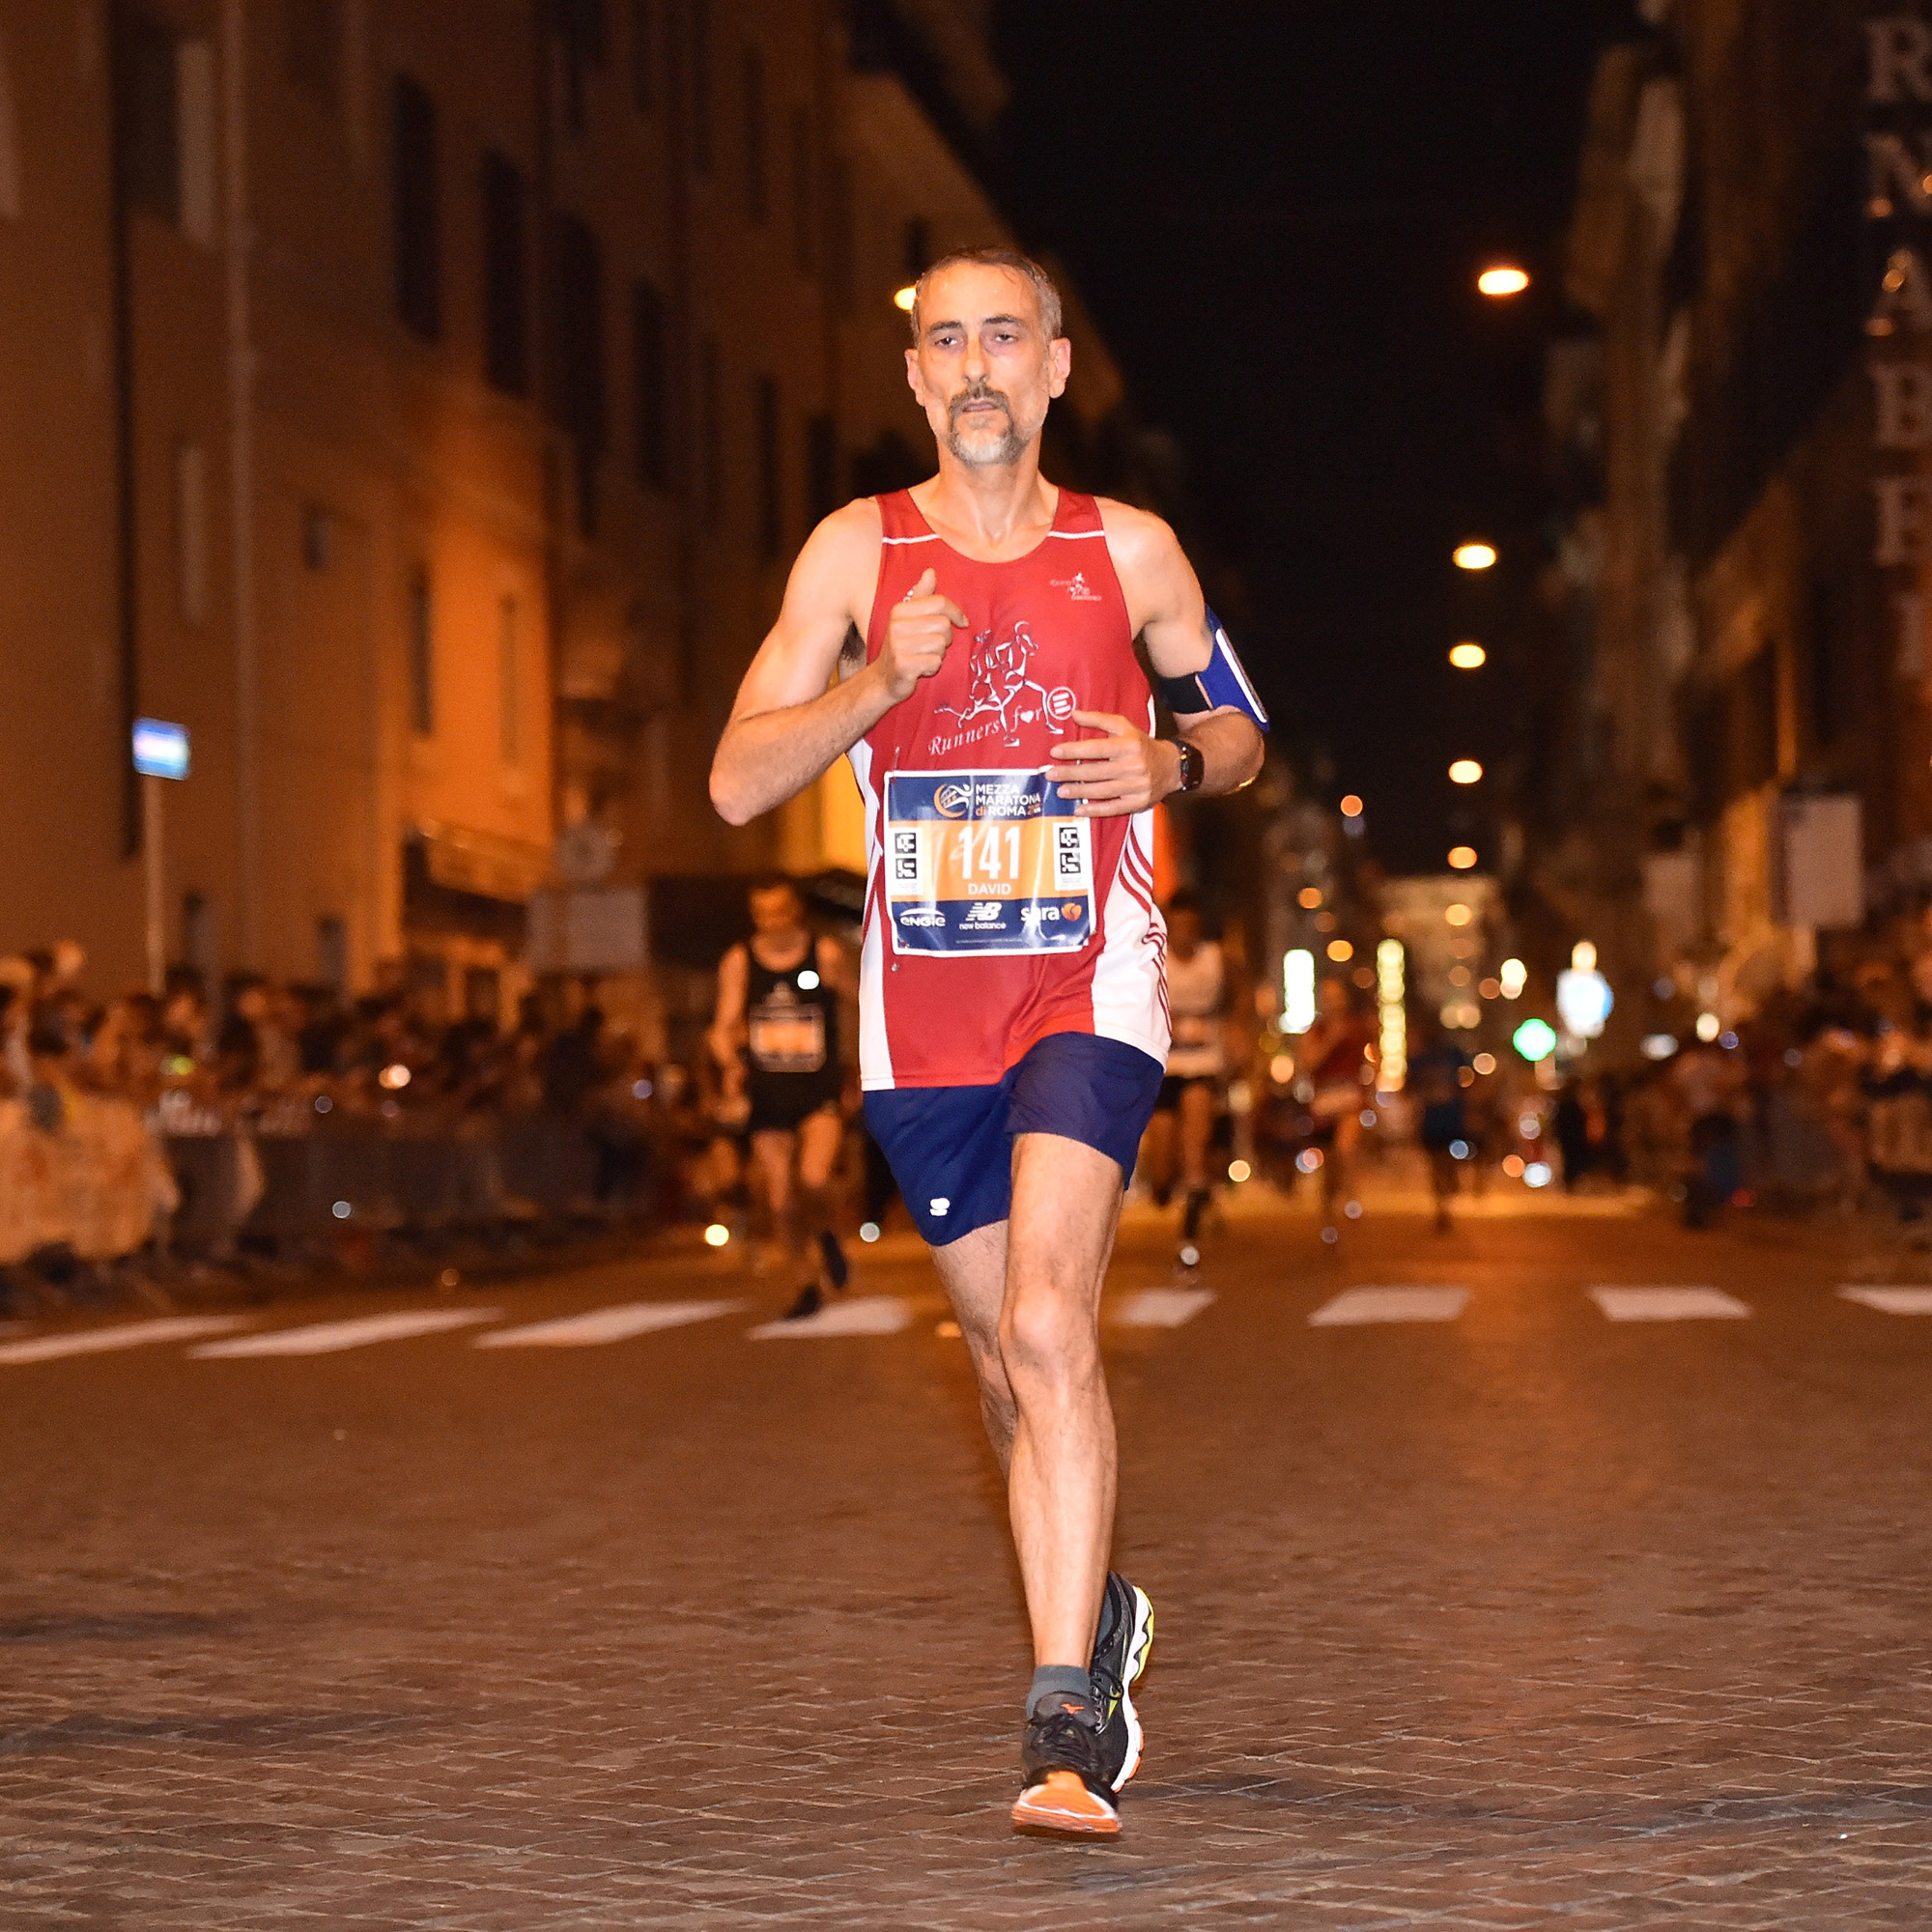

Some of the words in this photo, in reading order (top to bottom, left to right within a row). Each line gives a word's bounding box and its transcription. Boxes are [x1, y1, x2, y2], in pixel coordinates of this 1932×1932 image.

[928, 720, 1000, 755] Runners
[976, 783, 1020, 795] MEZZA
[976, 793, 1041, 806] MARATONA
[976, 806, 986, 816] di
[988, 806, 1027, 816] ROMA
[958, 826, 1021, 880] 141
[968, 883, 1011, 895] DAVID
